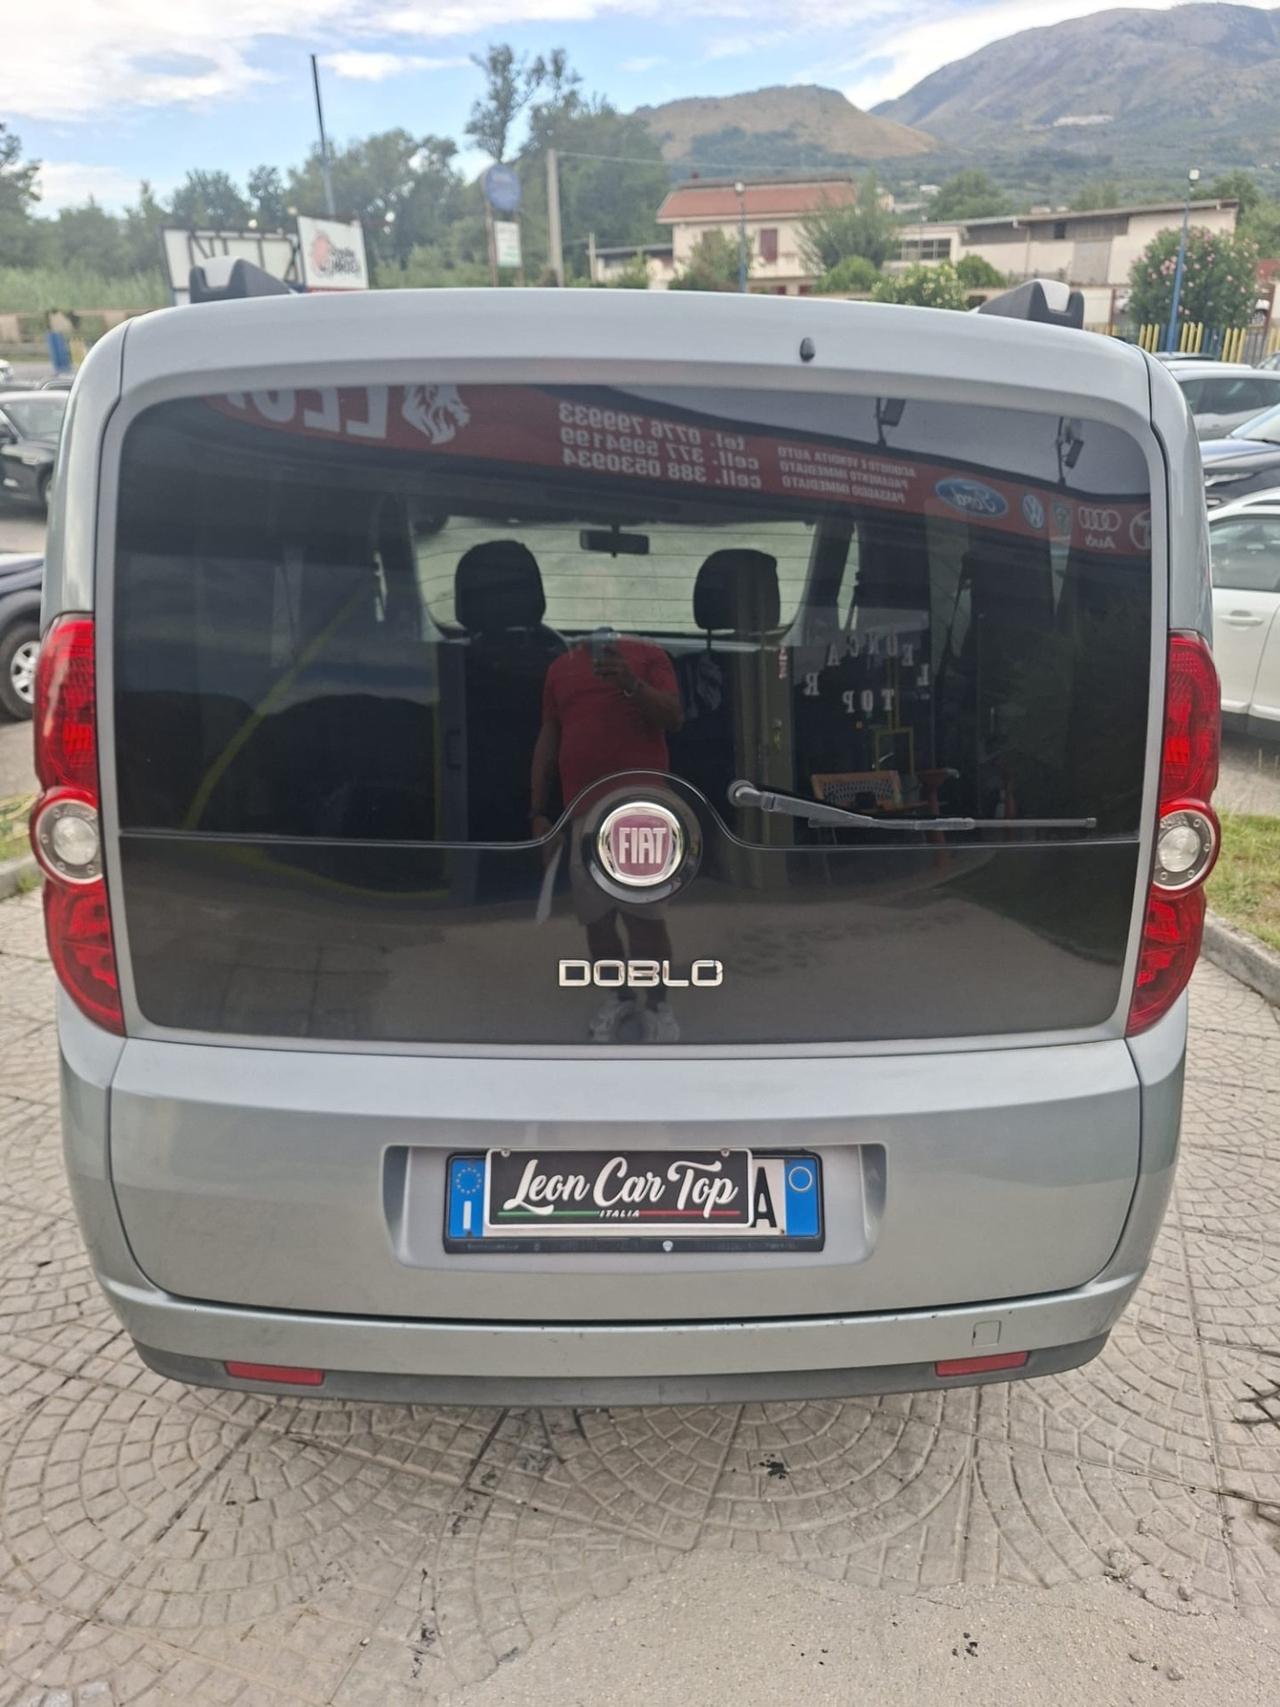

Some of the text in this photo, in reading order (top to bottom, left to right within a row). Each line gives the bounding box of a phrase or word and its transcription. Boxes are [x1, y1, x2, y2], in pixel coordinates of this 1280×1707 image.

[619, 827, 667, 864] FIAT
[559, 960, 723, 987] DOBLO
[503, 1156, 739, 1219] Leon Car Top
[751, 1167, 777, 1228] A
[463, 1201, 472, 1230] I
[600, 1209, 640, 1219] ITALIA
